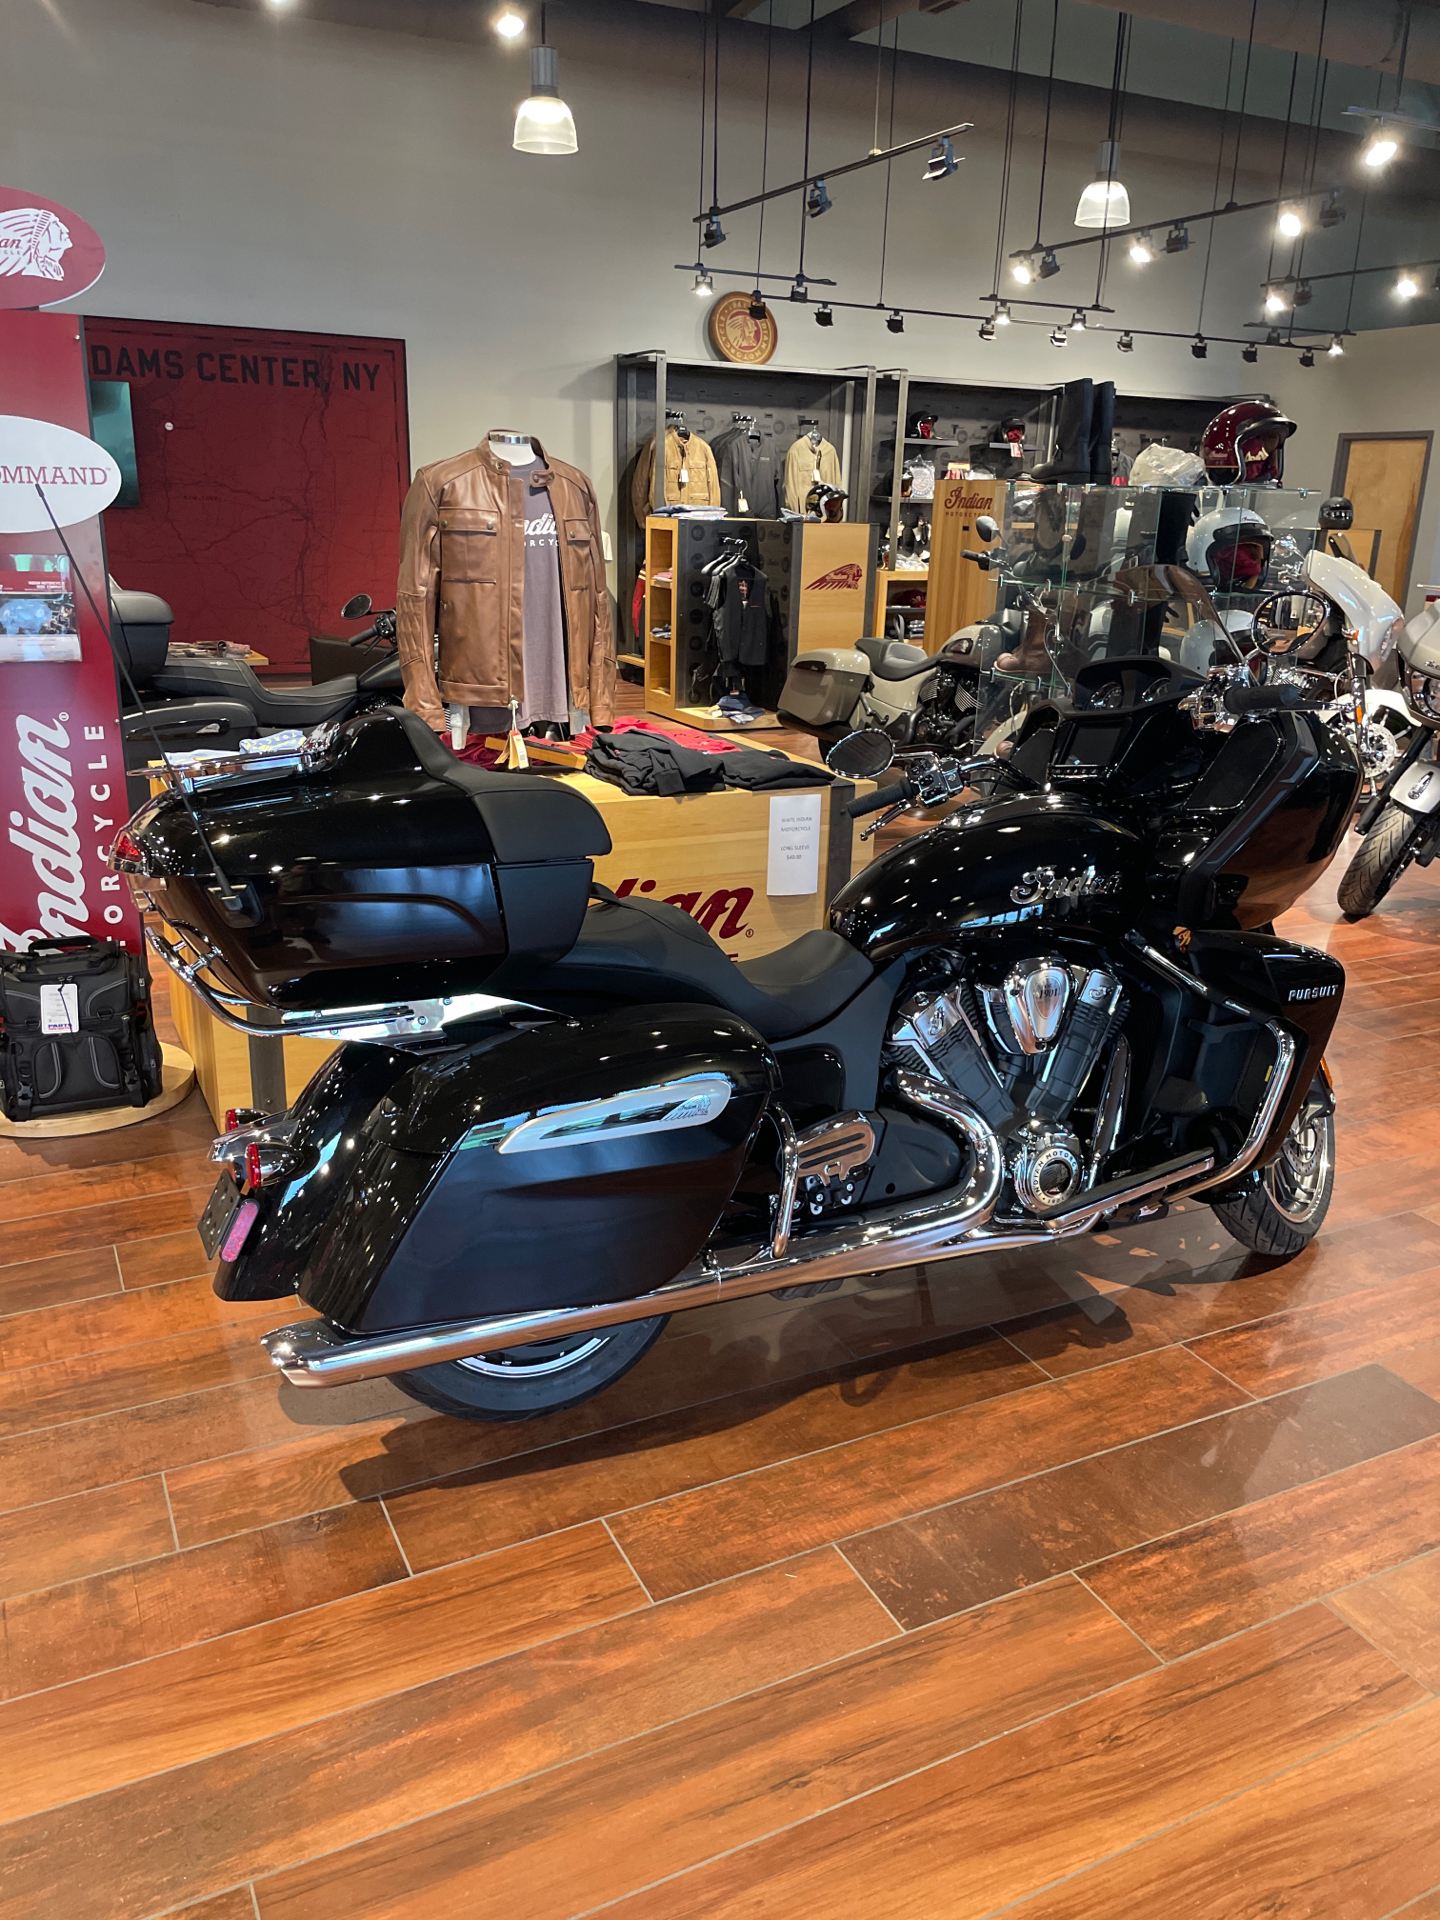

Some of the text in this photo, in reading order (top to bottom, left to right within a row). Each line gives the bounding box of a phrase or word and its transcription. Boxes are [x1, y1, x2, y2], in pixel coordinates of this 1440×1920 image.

[89, 344, 184, 380] DAMS
[343, 361, 381, 392] NY
[0, 465, 108, 485] MMAND
[944, 486, 994, 510] Indian
[84, 725, 126, 947] ORCYCLE
[1010, 865, 1122, 904] Indian
[1288, 984, 1339, 1002] PURSUIT
